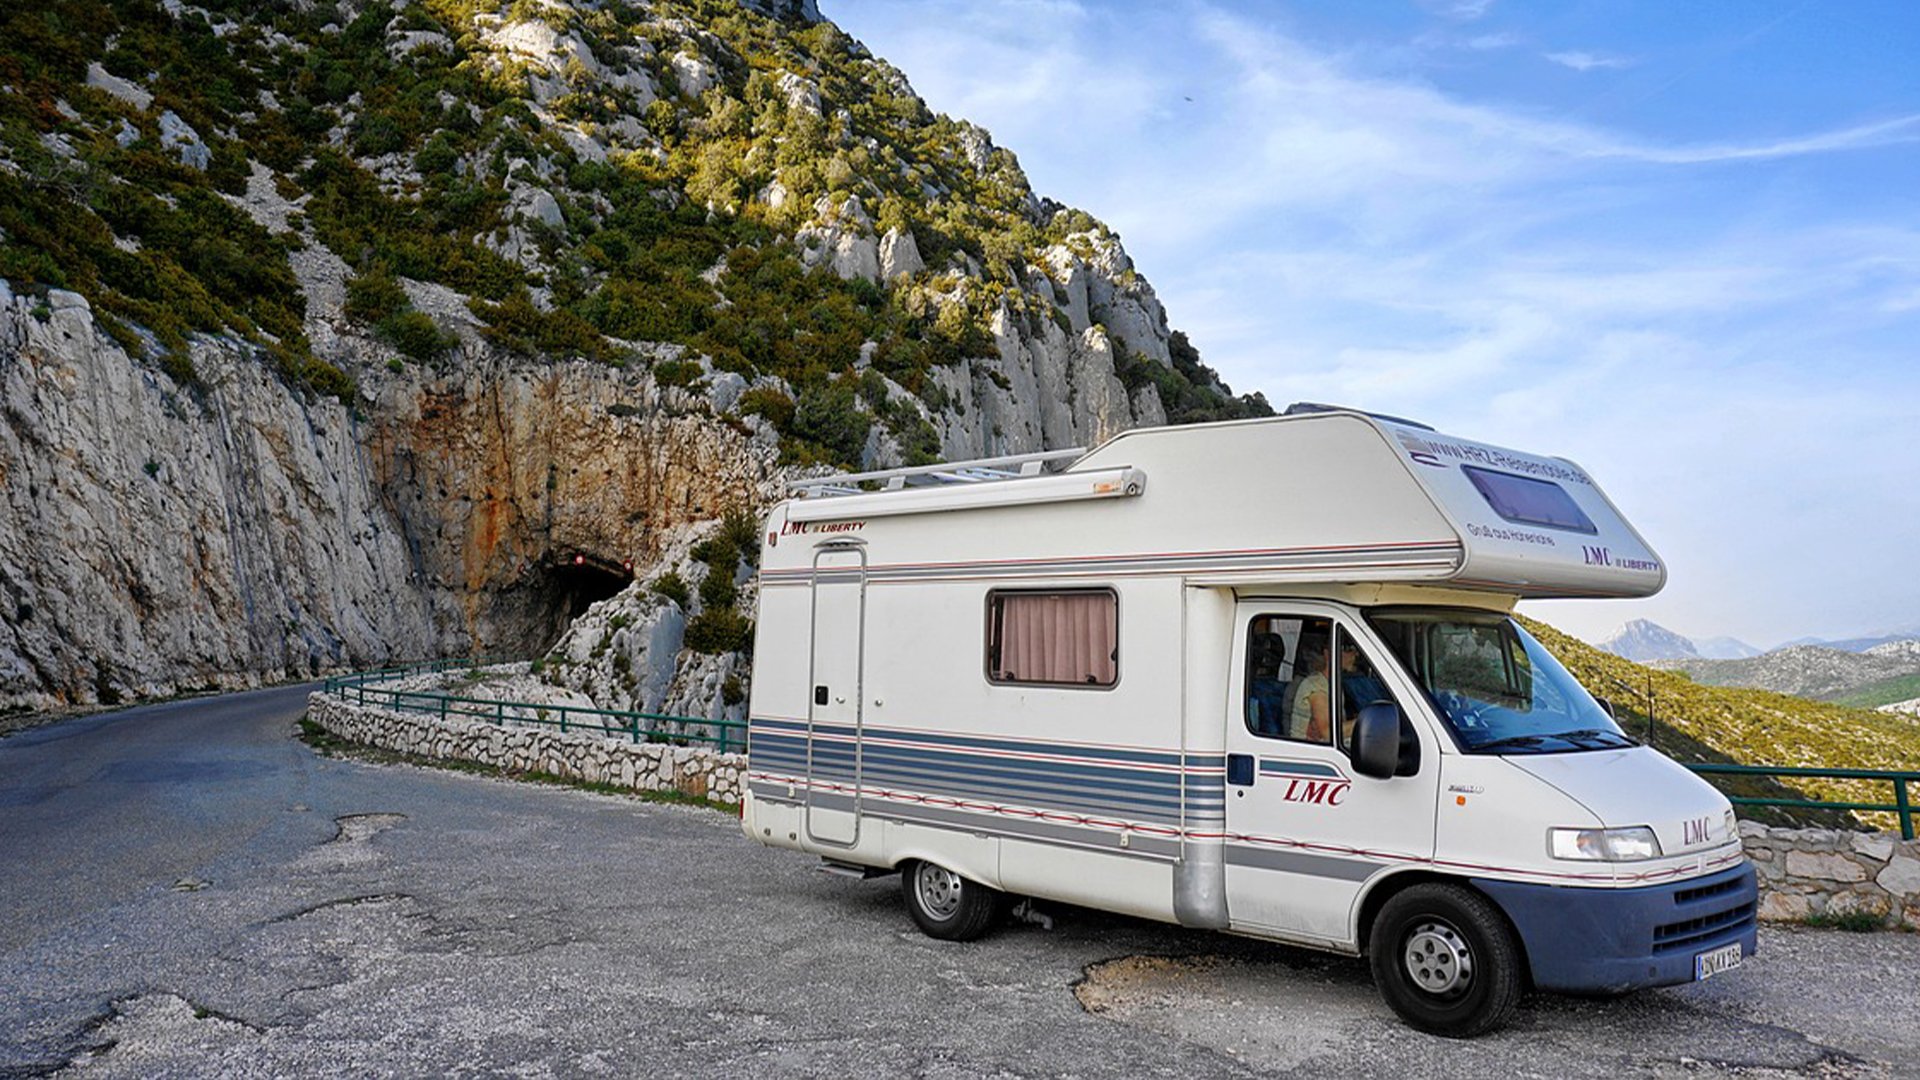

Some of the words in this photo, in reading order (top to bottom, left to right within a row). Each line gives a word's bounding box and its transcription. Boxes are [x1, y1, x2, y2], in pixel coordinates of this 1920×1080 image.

[780, 520, 809, 536] LMC
[821, 521, 867, 533] LIBERTY
[1583, 545, 1611, 567] LMC
[1622, 558, 1659, 571] LIBERTY
[1283, 780, 1351, 806] LMC
[1683, 816, 1711, 846] LMC
